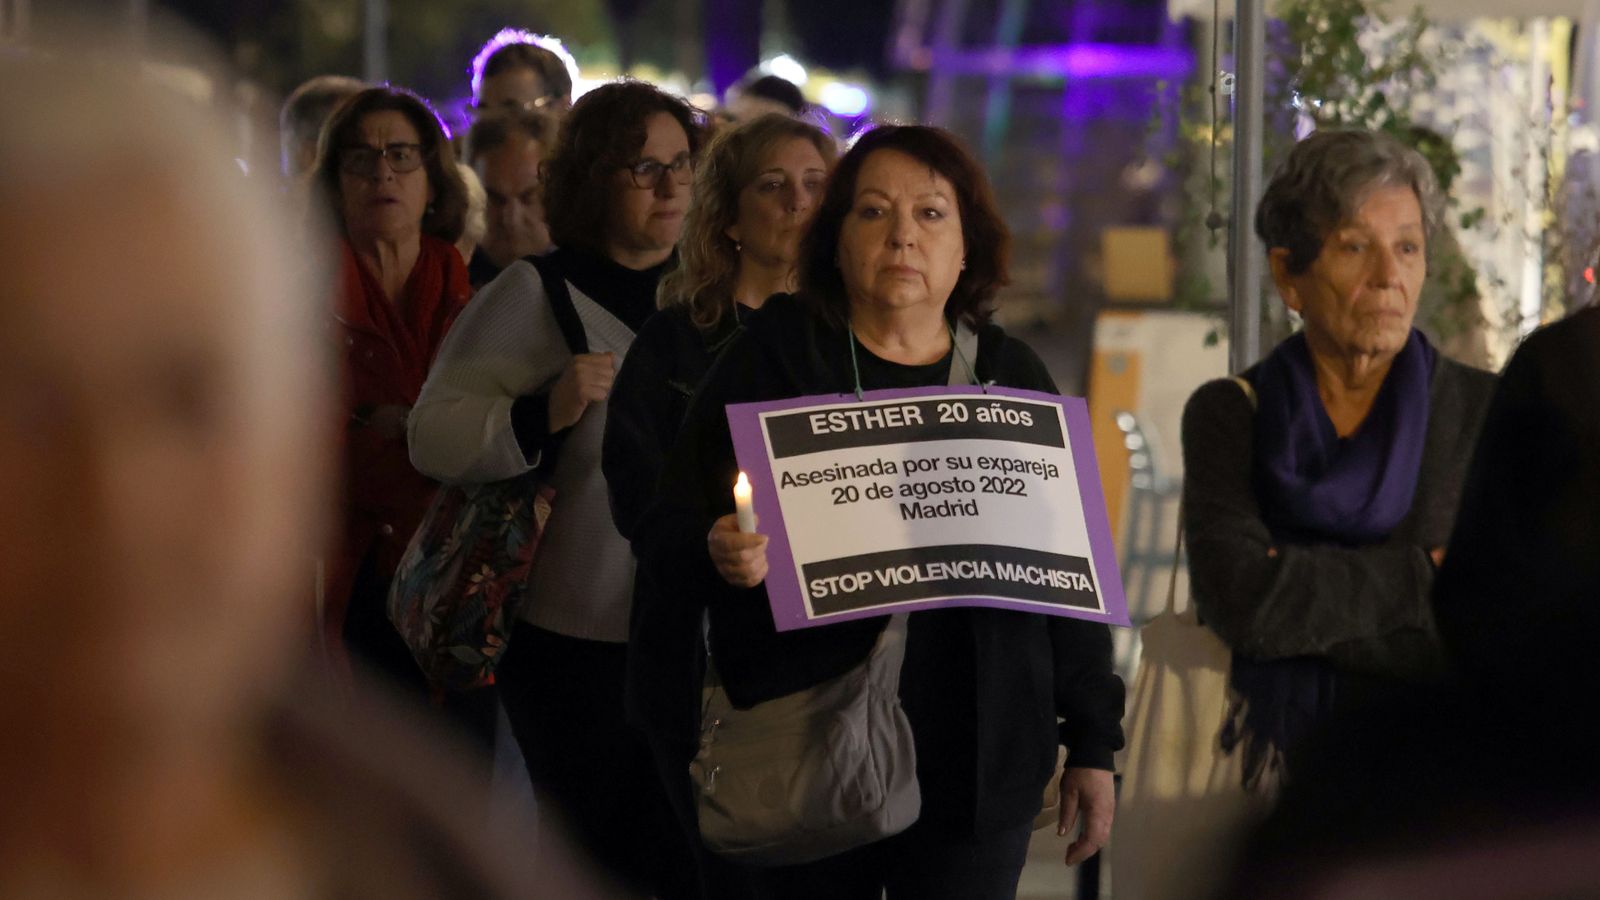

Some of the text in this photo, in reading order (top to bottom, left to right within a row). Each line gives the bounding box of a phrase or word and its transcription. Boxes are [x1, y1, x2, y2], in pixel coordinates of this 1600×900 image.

[809, 402, 1034, 435] ESTHER 20 años
[780, 455, 1059, 489] Asesinada por su expareja
[831, 476, 1028, 505] 20 de agosto 2022
[899, 499, 979, 521] Madrid
[809, 561, 1095, 599] STOP VIOLENCIA MACHISTA
